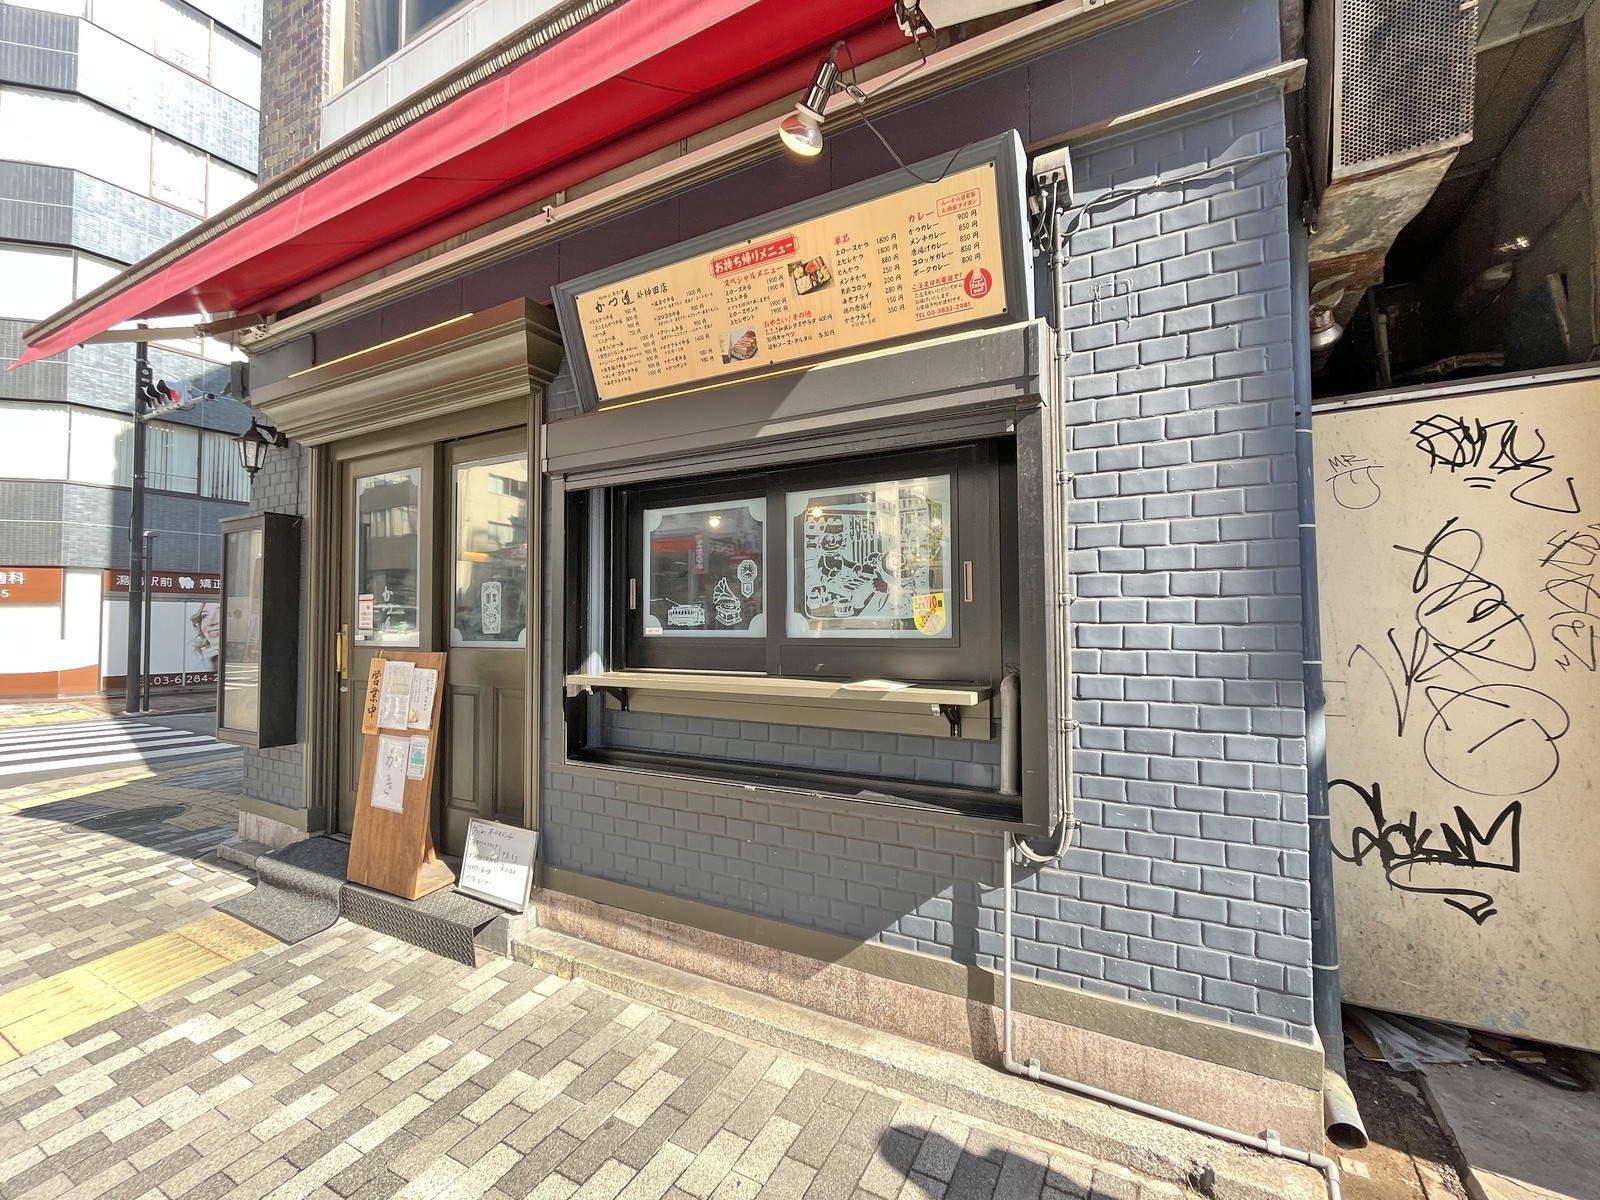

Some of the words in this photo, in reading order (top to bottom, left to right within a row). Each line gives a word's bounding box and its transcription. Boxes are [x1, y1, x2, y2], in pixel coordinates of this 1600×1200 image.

[908, 211, 934, 223] カレー
[908, 223, 938, 235] かつカレー
[957, 209, 977, 220] 900円
[834, 233, 850, 245] 単品
[911, 232, 946, 245] メンチカレー
[958, 220, 978, 231] 850円
[836, 242, 869, 256] 上ロースかつ
[912, 242, 948, 256] 唐揚げカレー
[960, 231, 979, 242] 850円
[714, 242, 793, 274] お持ち帰りメニュー
[837, 254, 864, 266] 上ヒレかつ
[912, 252, 953, 266] コロッケカレー
[961, 242, 980, 253] 850円
[724, 266, 783, 287] スペシャルメニュー
[838, 265, 859, 276] とんかつ
[840, 274, 867, 285] メンチかつ
[883, 264, 900, 274] 250円
[913, 264, 949, 276] ポークカレー
[637, 283, 667, 298] 外神田店
[729, 306, 758, 318] 上ロースサンド
[927, 302, 970, 316] 03-3832-2981
[731, 315, 754, 325] 上ヒレサンド
[845, 312, 870, 324] かきフライ
[367, 669, 382, 718] 営業中
[384, 749, 398, 795] かき
